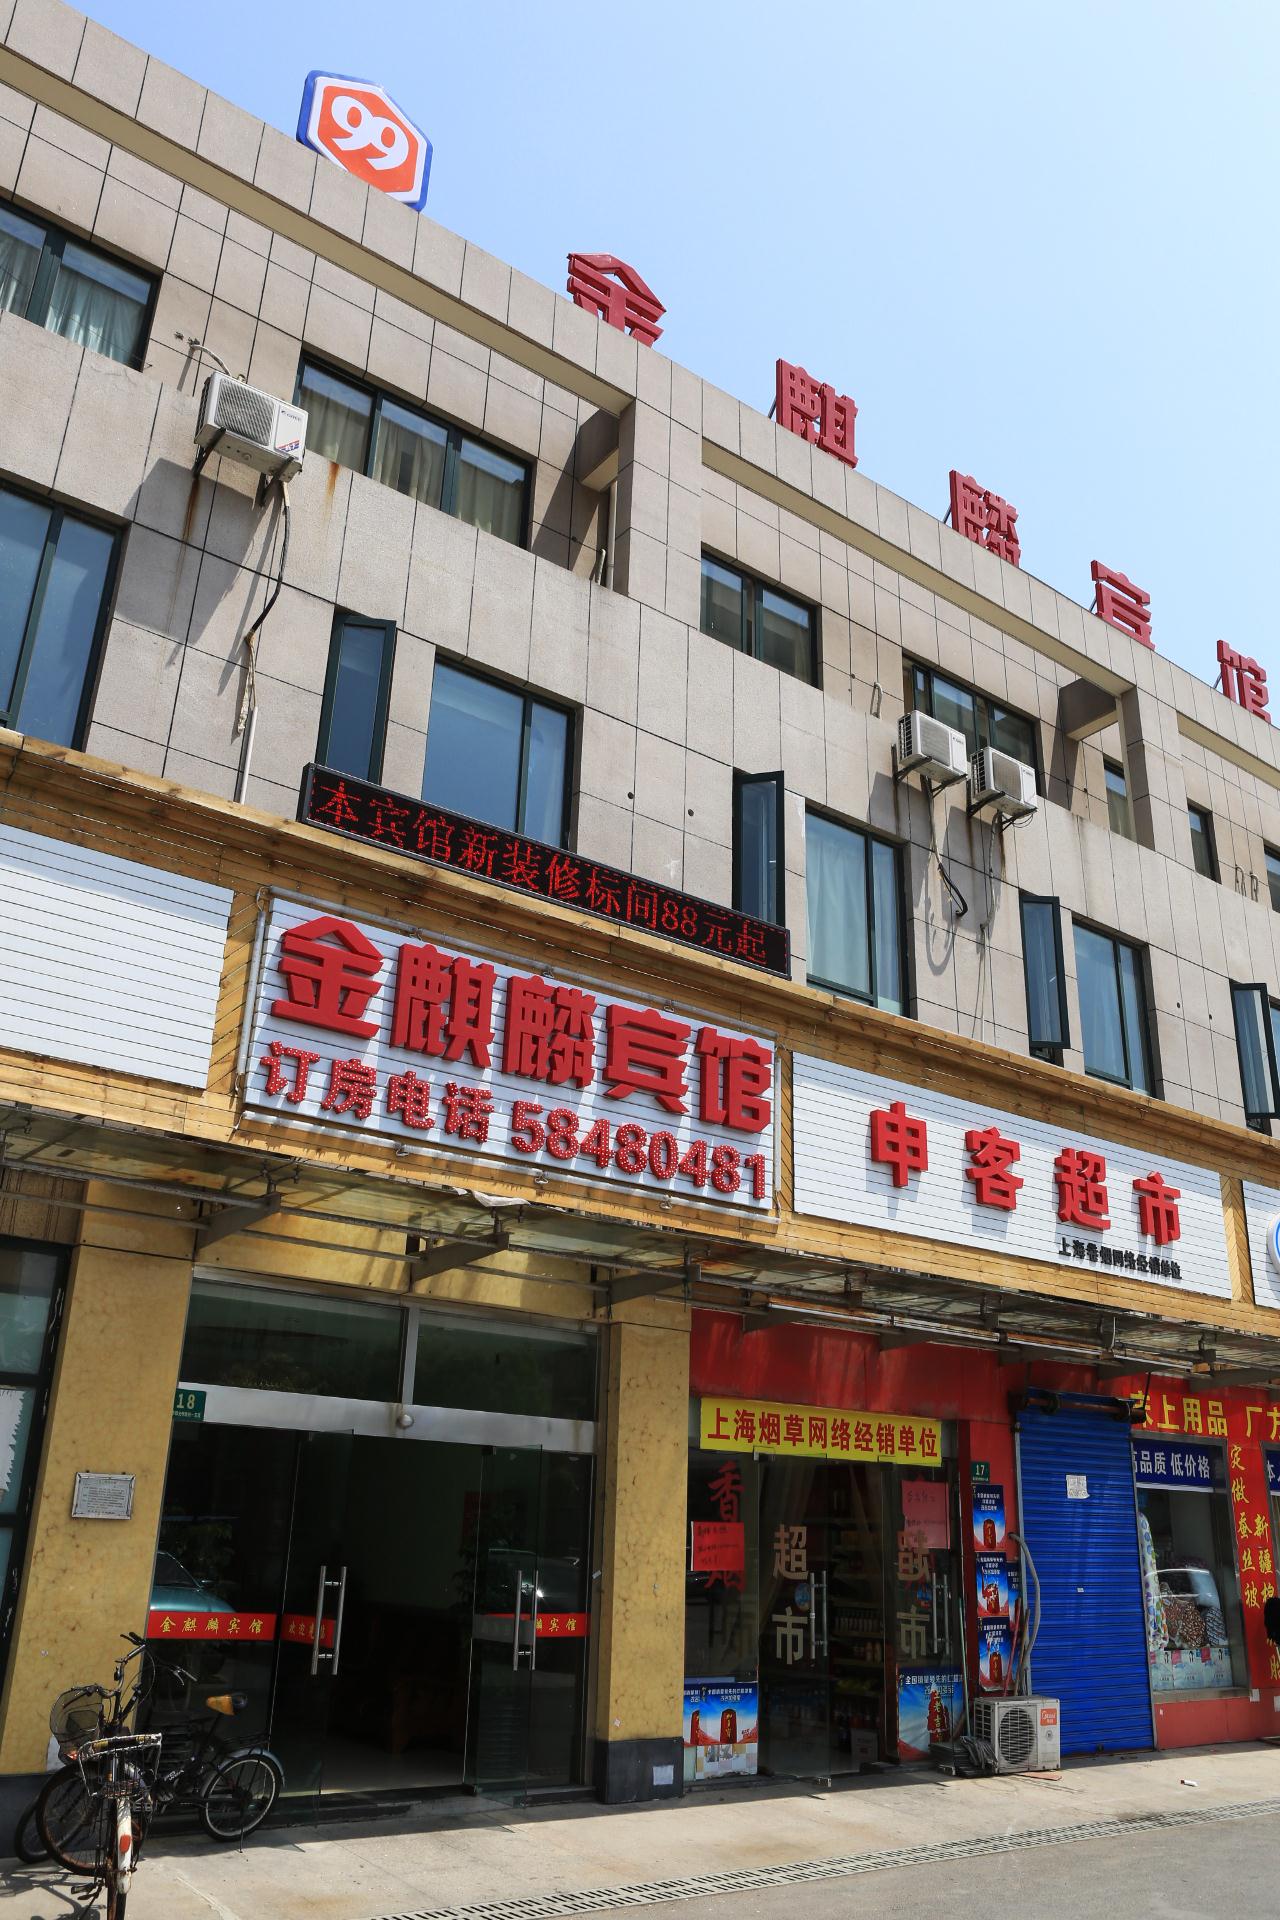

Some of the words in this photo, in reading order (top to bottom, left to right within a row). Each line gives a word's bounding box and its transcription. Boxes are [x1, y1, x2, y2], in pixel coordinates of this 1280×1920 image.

[331, 95, 409, 171] 99
[316, 780, 768, 965] 本宾馆新装修标间88元起
[271, 915, 774, 1133] 金麒麟宾馆
[259, 1040, 495, 1145] 订房电话
[510, 1100, 767, 1199] 58480481
[870, 1100, 1182, 1246] 申客超市
[176, 1393, 196, 1409] 18
[707, 1407, 938, 1458] 上海烟草网络经销单位
[975, 1464, 985, 1475] 17
[1171, 1452, 1210, 1479] 低价格
[160, 1616, 264, 1634] 金麒麟宾馆
[772, 1523, 809, 1665] 超市
